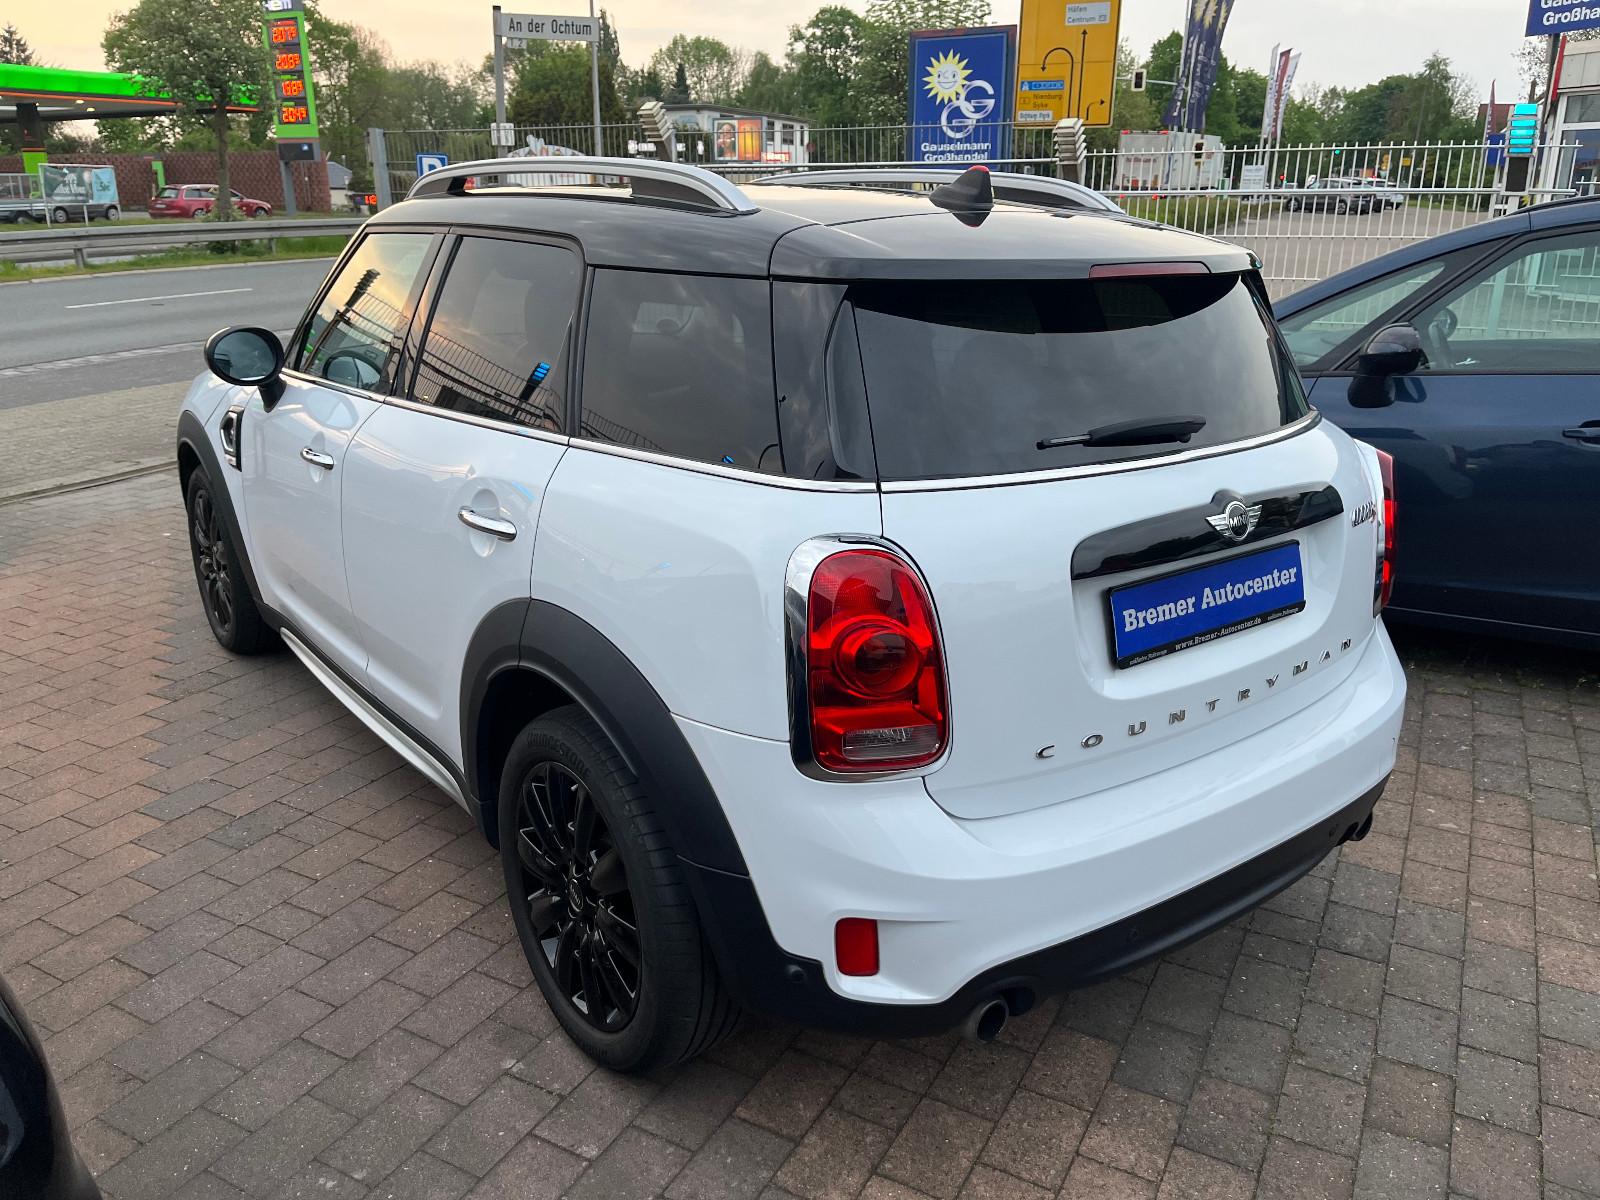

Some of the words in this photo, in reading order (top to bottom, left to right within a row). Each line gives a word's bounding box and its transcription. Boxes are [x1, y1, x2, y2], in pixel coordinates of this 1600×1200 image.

[508, 17, 522, 32] An
[527, 18, 545, 33] der
[551, 19, 592, 35] Ochtum
[921, 142, 991, 151] Gauselmann
[924, 152, 988, 161] Großhandel
[1123, 594, 1196, 632] Bremer
[1202, 566, 1297, 610] Autocenter
[1175, 616, 1262, 651] www.Bremer-Autocenter.de
[1035, 638, 1352, 760] COUNTRYMAN
